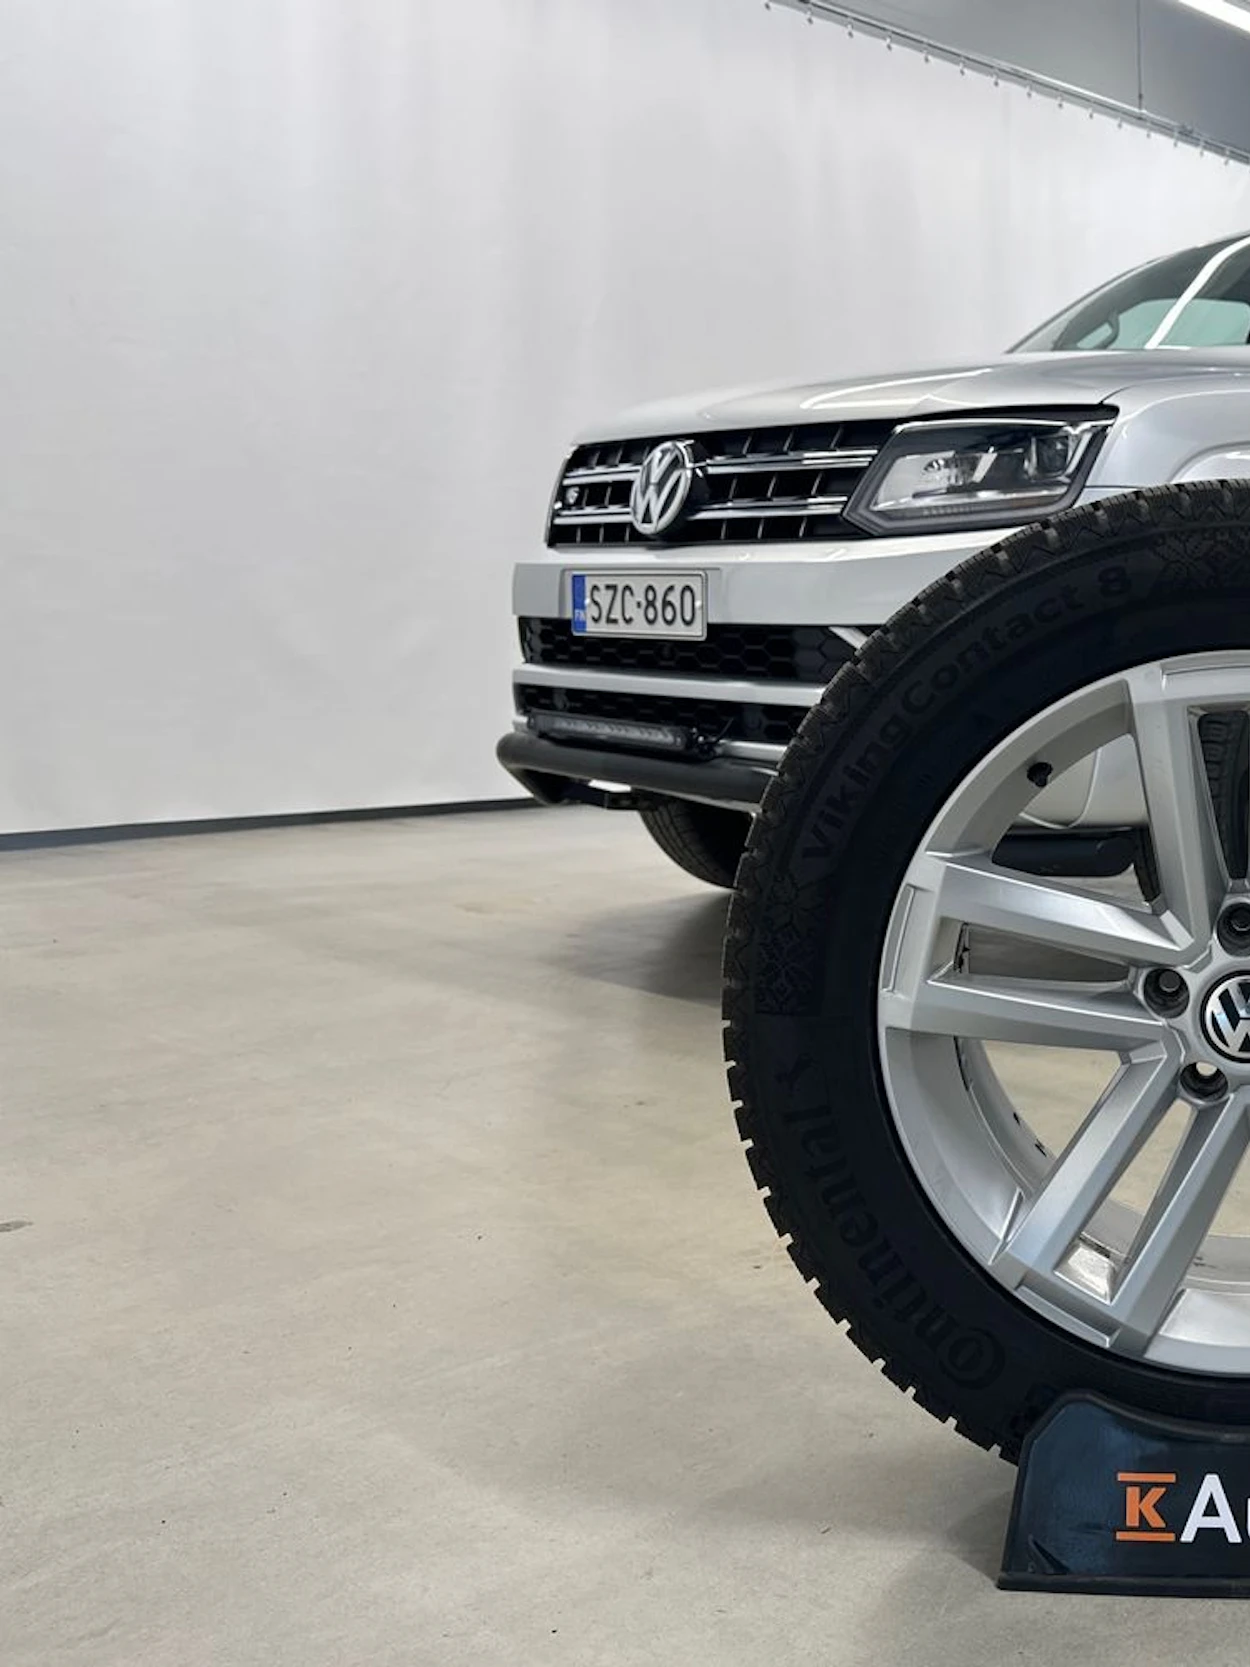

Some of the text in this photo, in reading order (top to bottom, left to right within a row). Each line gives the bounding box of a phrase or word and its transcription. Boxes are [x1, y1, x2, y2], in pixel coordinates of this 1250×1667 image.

[802, 565, 1132, 859] VikingContact 8
[782, 1105, 1005, 1389] Continental
